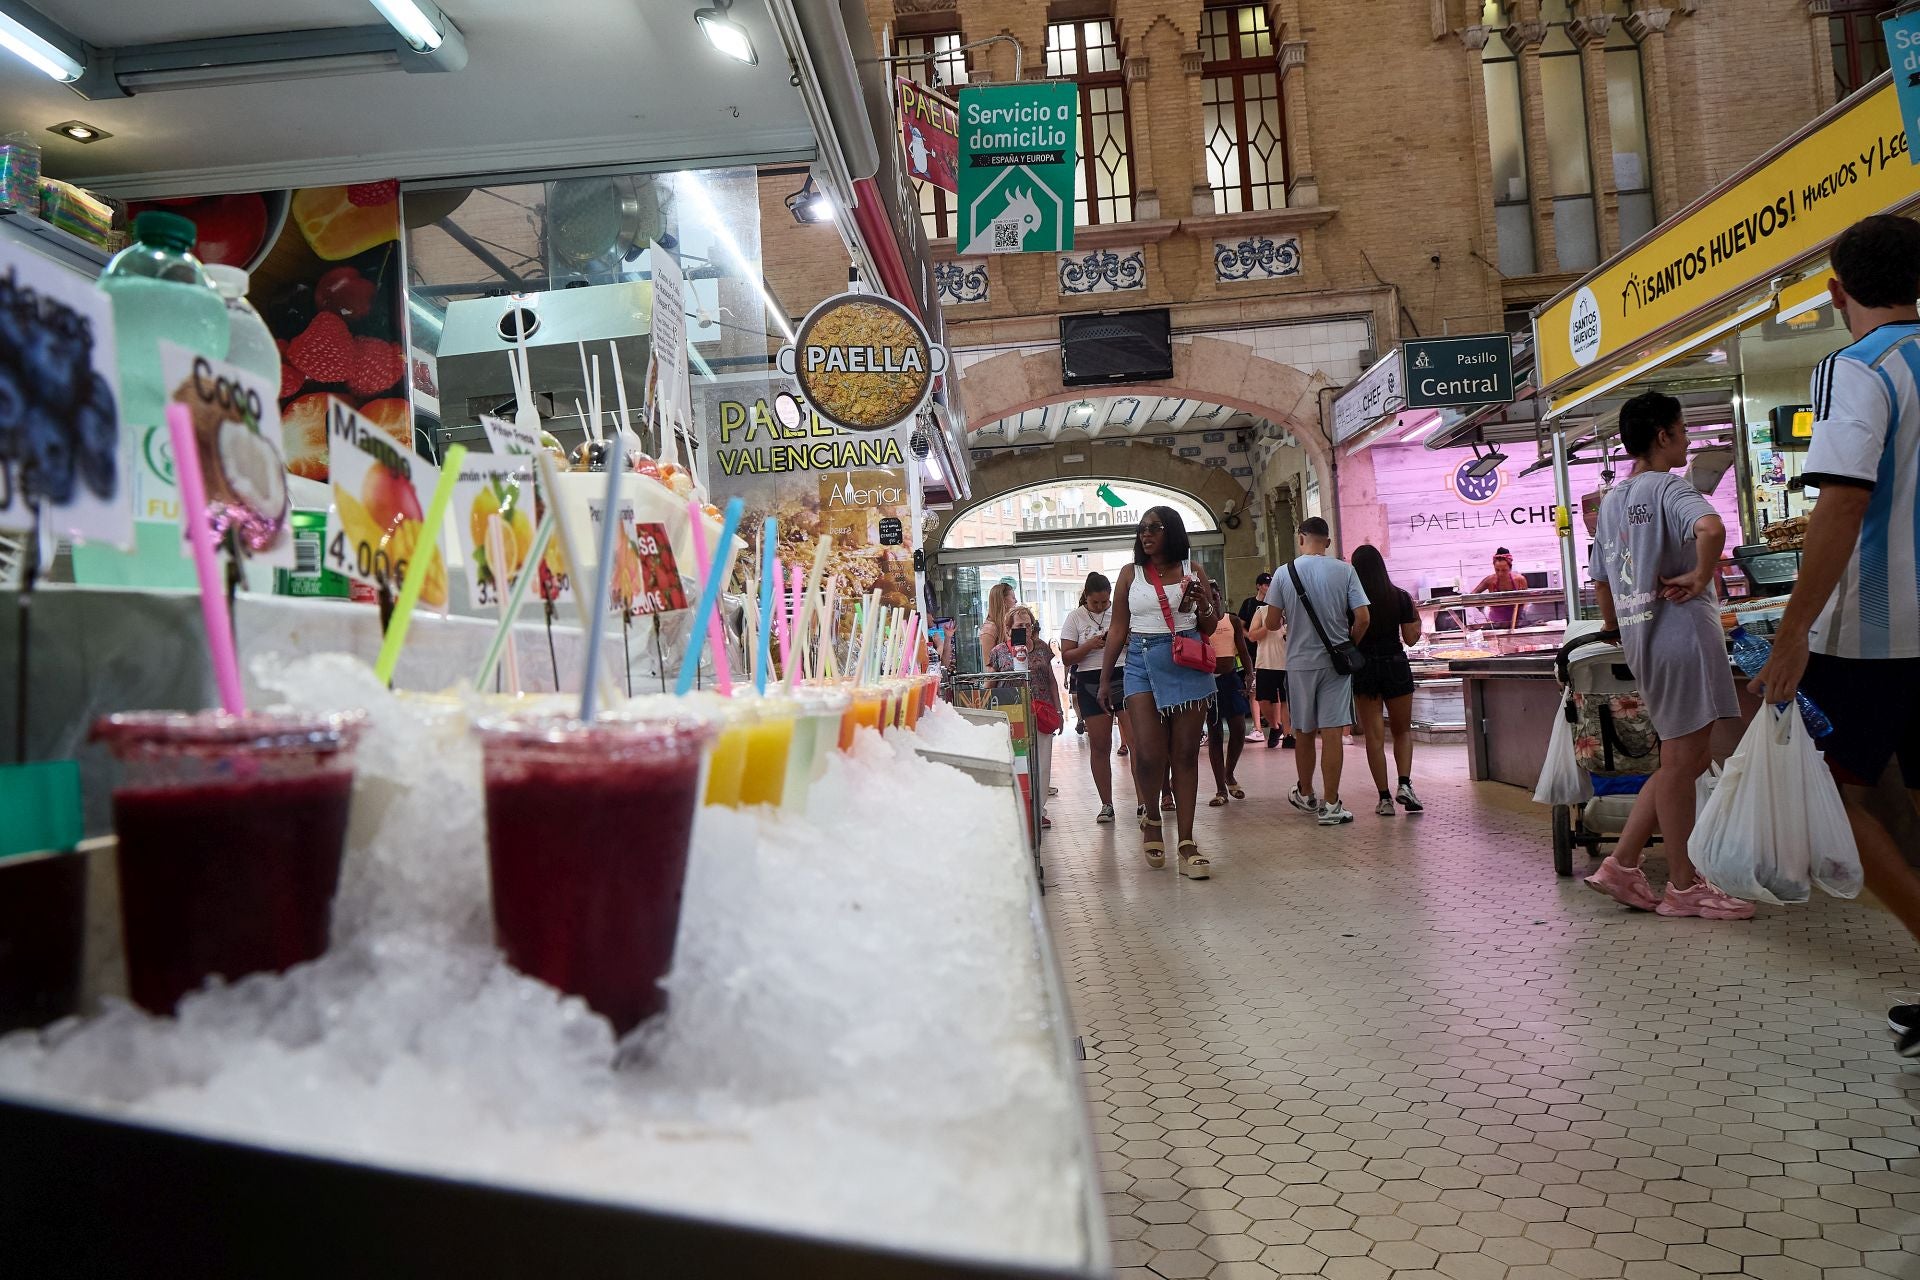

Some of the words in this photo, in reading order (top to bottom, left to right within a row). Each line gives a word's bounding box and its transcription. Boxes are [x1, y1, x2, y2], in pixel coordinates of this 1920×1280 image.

[967, 101, 1051, 125] Servicio
[1057, 105, 1069, 121] a
[969, 125, 1066, 150] domicilio
[991, 154, 1019, 165] ESPAÑA
[1020, 155, 1026, 163] Y
[1026, 153, 1055, 163] EUROPA
[1643, 245, 1707, 305] ¡SANTOS
[1709, 190, 1796, 267] HUEVOS!
[1802, 161, 1858, 212] HUEVOS
[1860, 145, 1875, 177] Y
[1573, 323, 1598, 346] HUEVOS!
[807, 345, 925, 373] PAELLA
[1457, 352, 1497, 365] Pasillo
[193, 355, 263, 421] Coco
[1420, 373, 1498, 397] Central
[1362, 385, 1381, 411] CHEF
[717, 437, 905, 476] VALENCIANA
